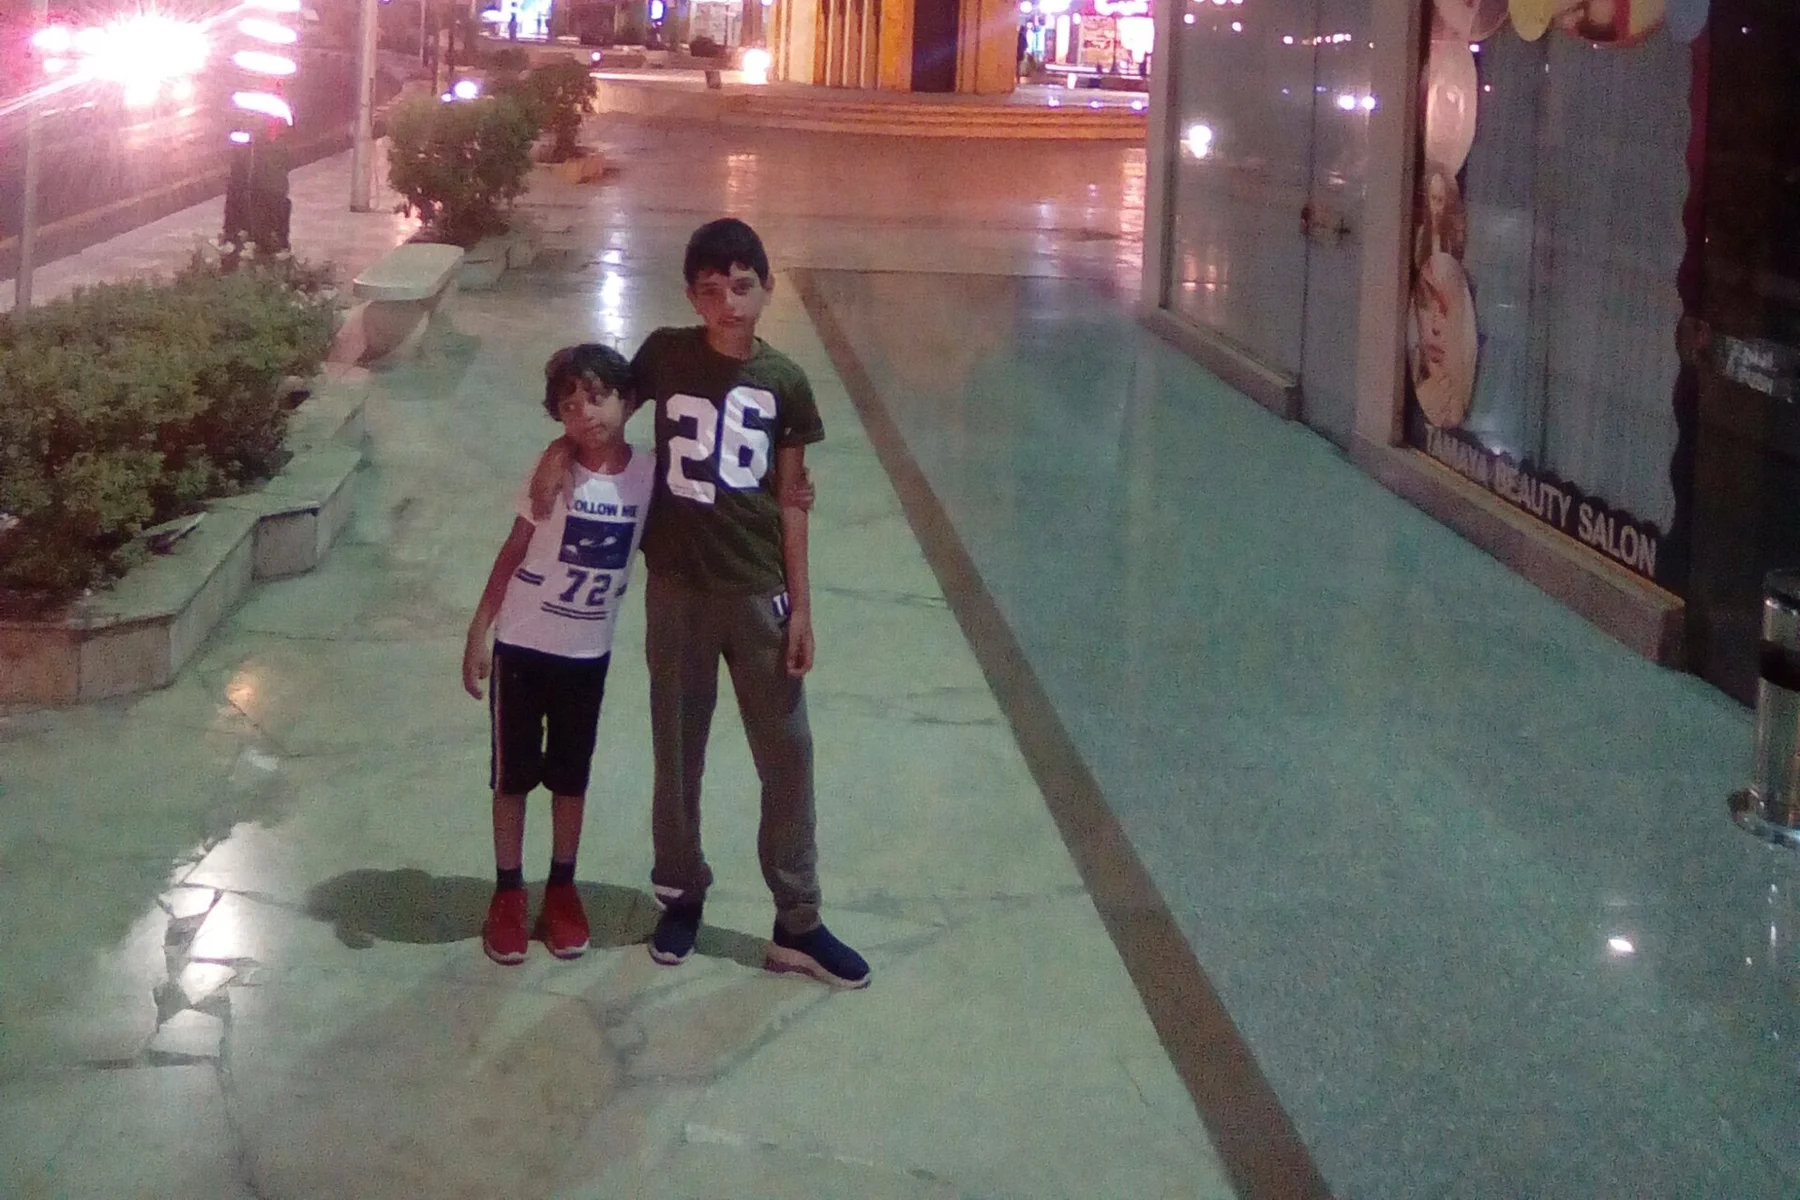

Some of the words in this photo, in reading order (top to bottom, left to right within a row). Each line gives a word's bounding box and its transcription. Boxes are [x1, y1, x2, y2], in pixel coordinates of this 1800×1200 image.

[666, 384, 778, 504] 26
[1578, 502, 1657, 576] SALON
[559, 568, 612, 606] 72
